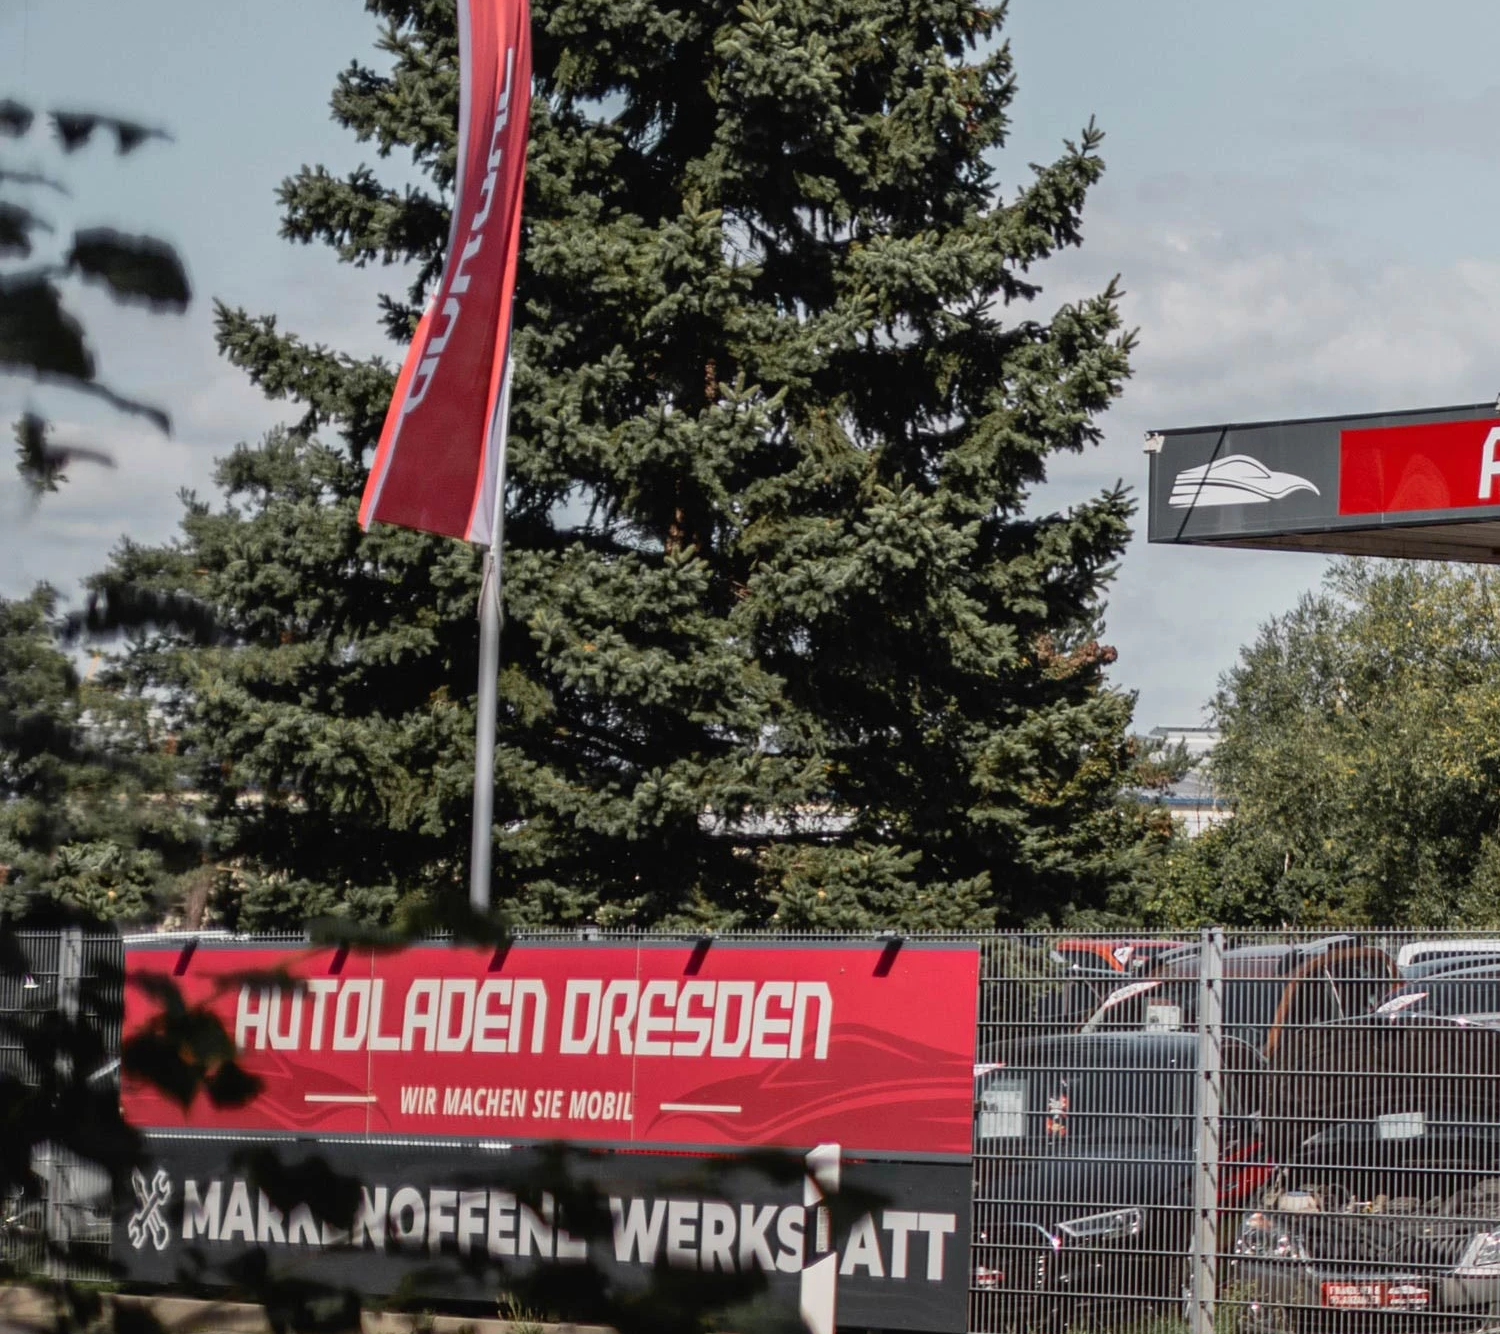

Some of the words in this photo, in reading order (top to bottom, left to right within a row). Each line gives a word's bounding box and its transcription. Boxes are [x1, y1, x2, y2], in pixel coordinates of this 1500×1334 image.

[235, 977, 548, 1053] AUTOLADEN
[559, 978, 833, 1060] DRESDEN
[400, 1086, 437, 1116] WIR
[441, 1086, 527, 1120] MACHEN
[532, 1089, 564, 1119] SIE
[567, 1090, 634, 1122] MOBIL
[609, 1196, 956, 1282] WERKSATT
